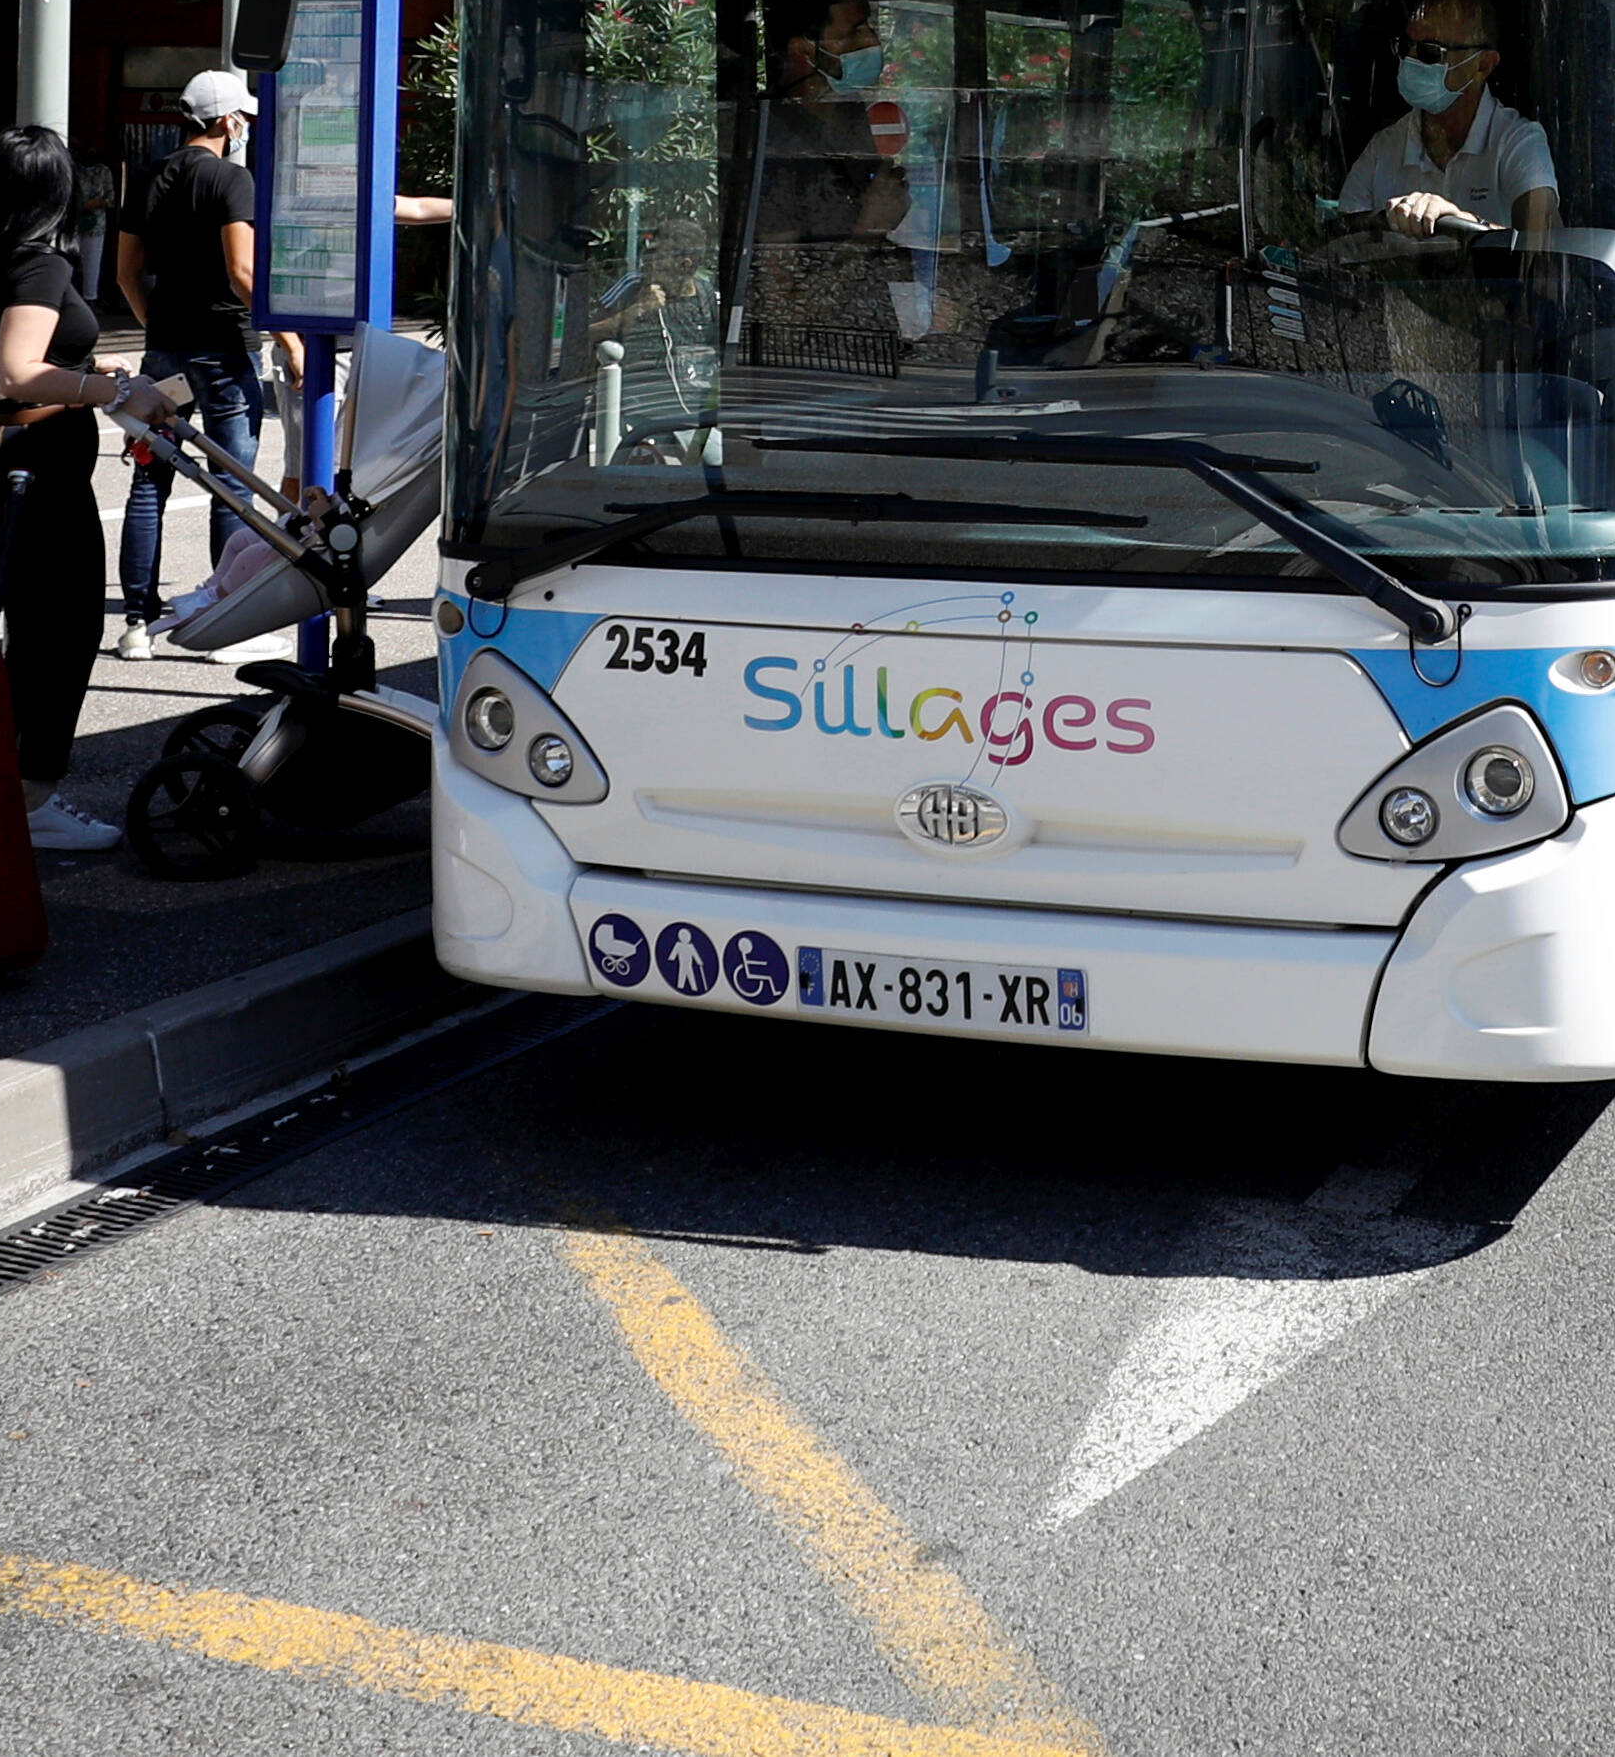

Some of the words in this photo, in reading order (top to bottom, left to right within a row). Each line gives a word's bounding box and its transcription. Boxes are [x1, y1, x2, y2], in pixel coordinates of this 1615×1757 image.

[605, 624, 708, 678] 2534
[743, 655, 1156, 767] Sillages
[829, 959, 1051, 1026] AX-831-XR
